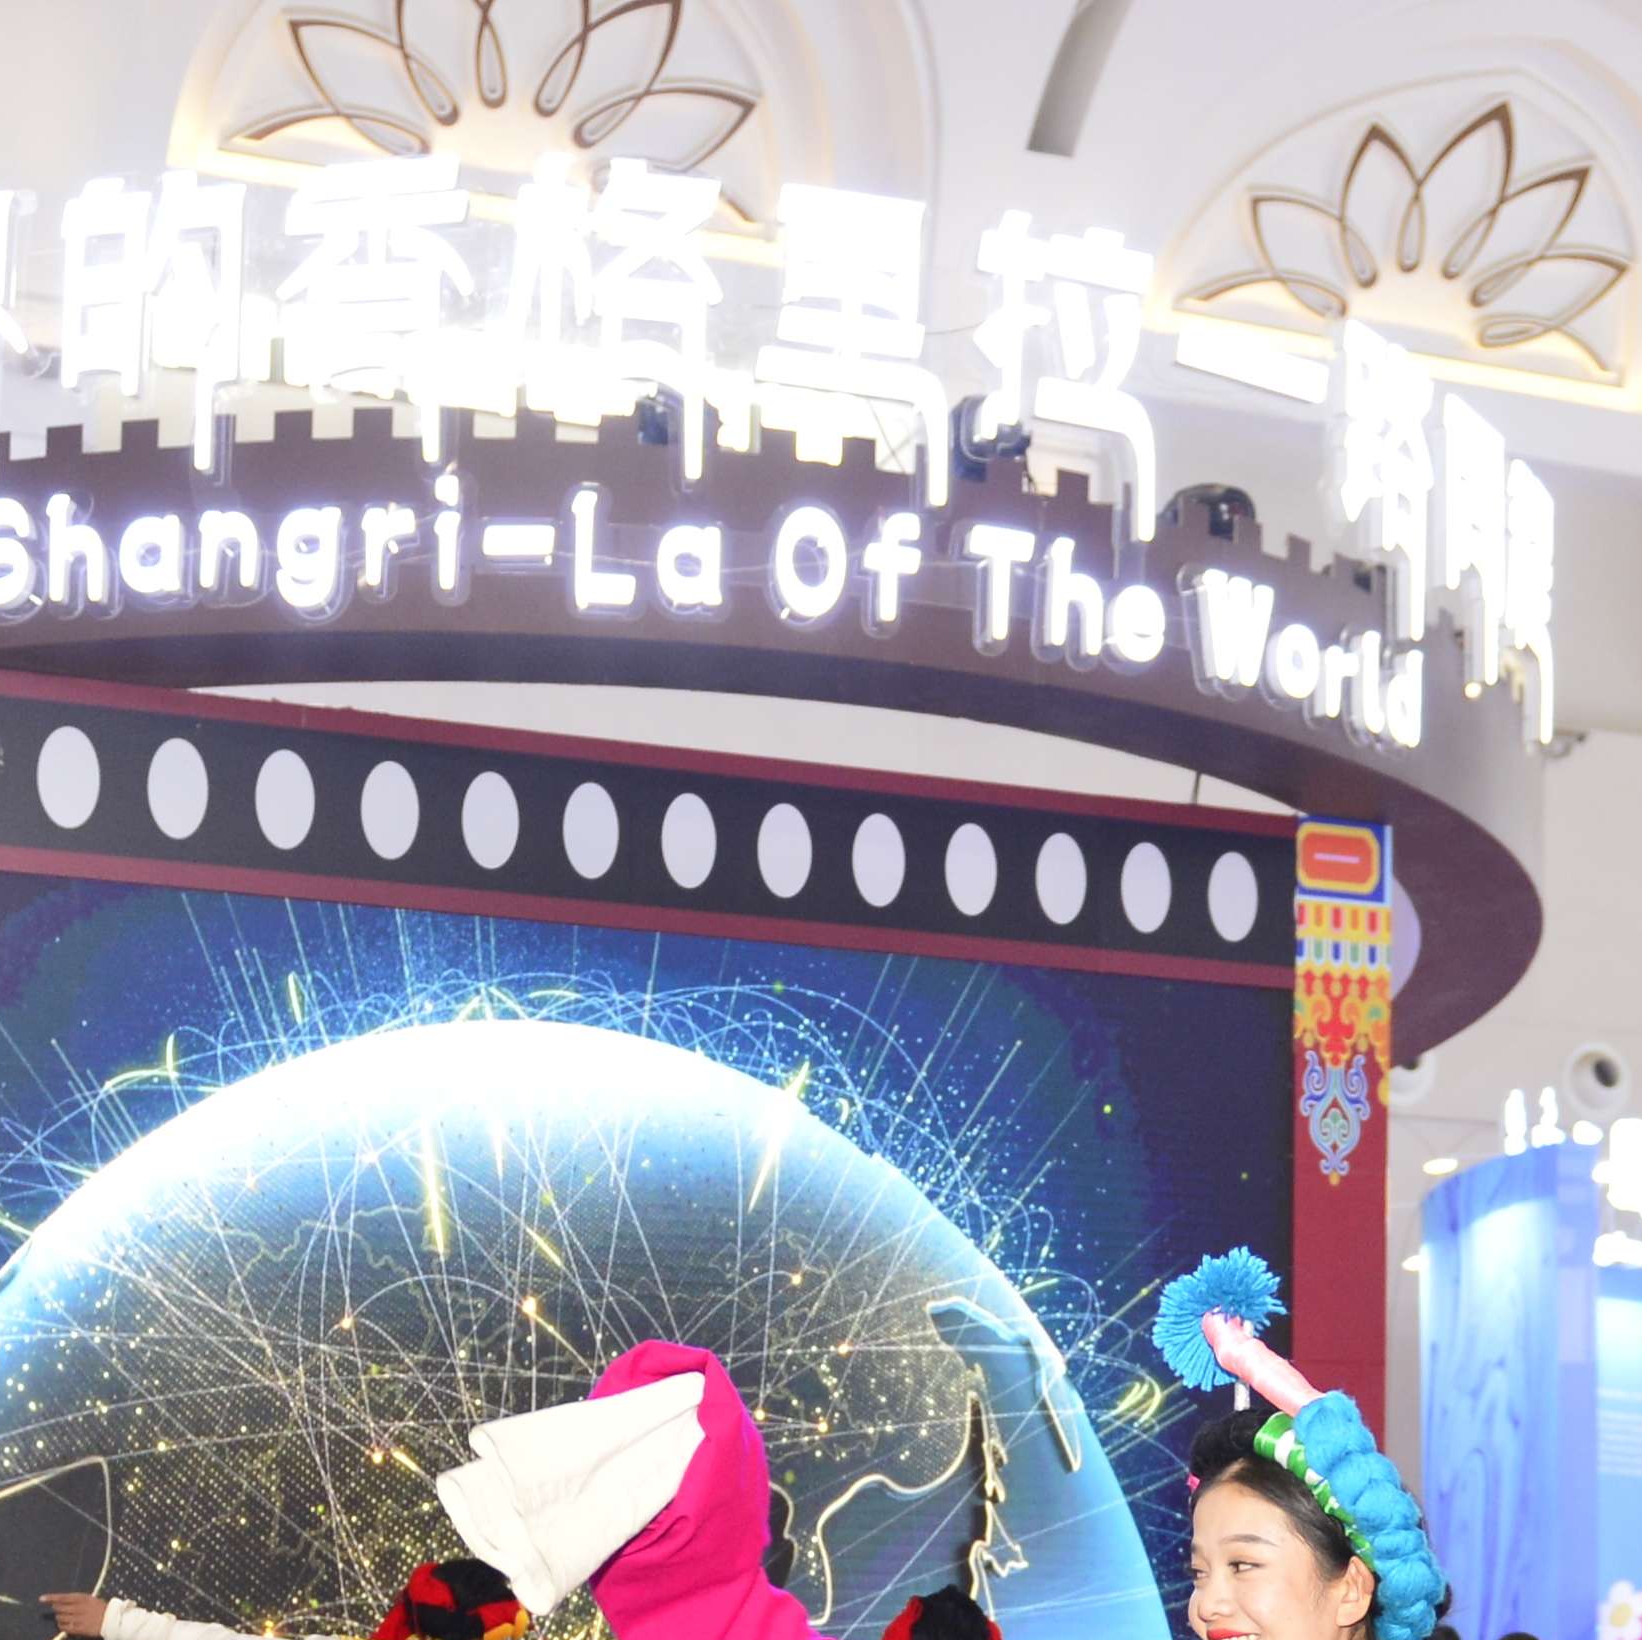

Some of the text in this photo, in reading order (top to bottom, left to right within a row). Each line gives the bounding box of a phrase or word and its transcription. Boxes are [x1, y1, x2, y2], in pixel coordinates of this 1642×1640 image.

[773, 505, 921, 622] Of
[967, 523, 1166, 663] The
[1195, 568, 1424, 748] World
